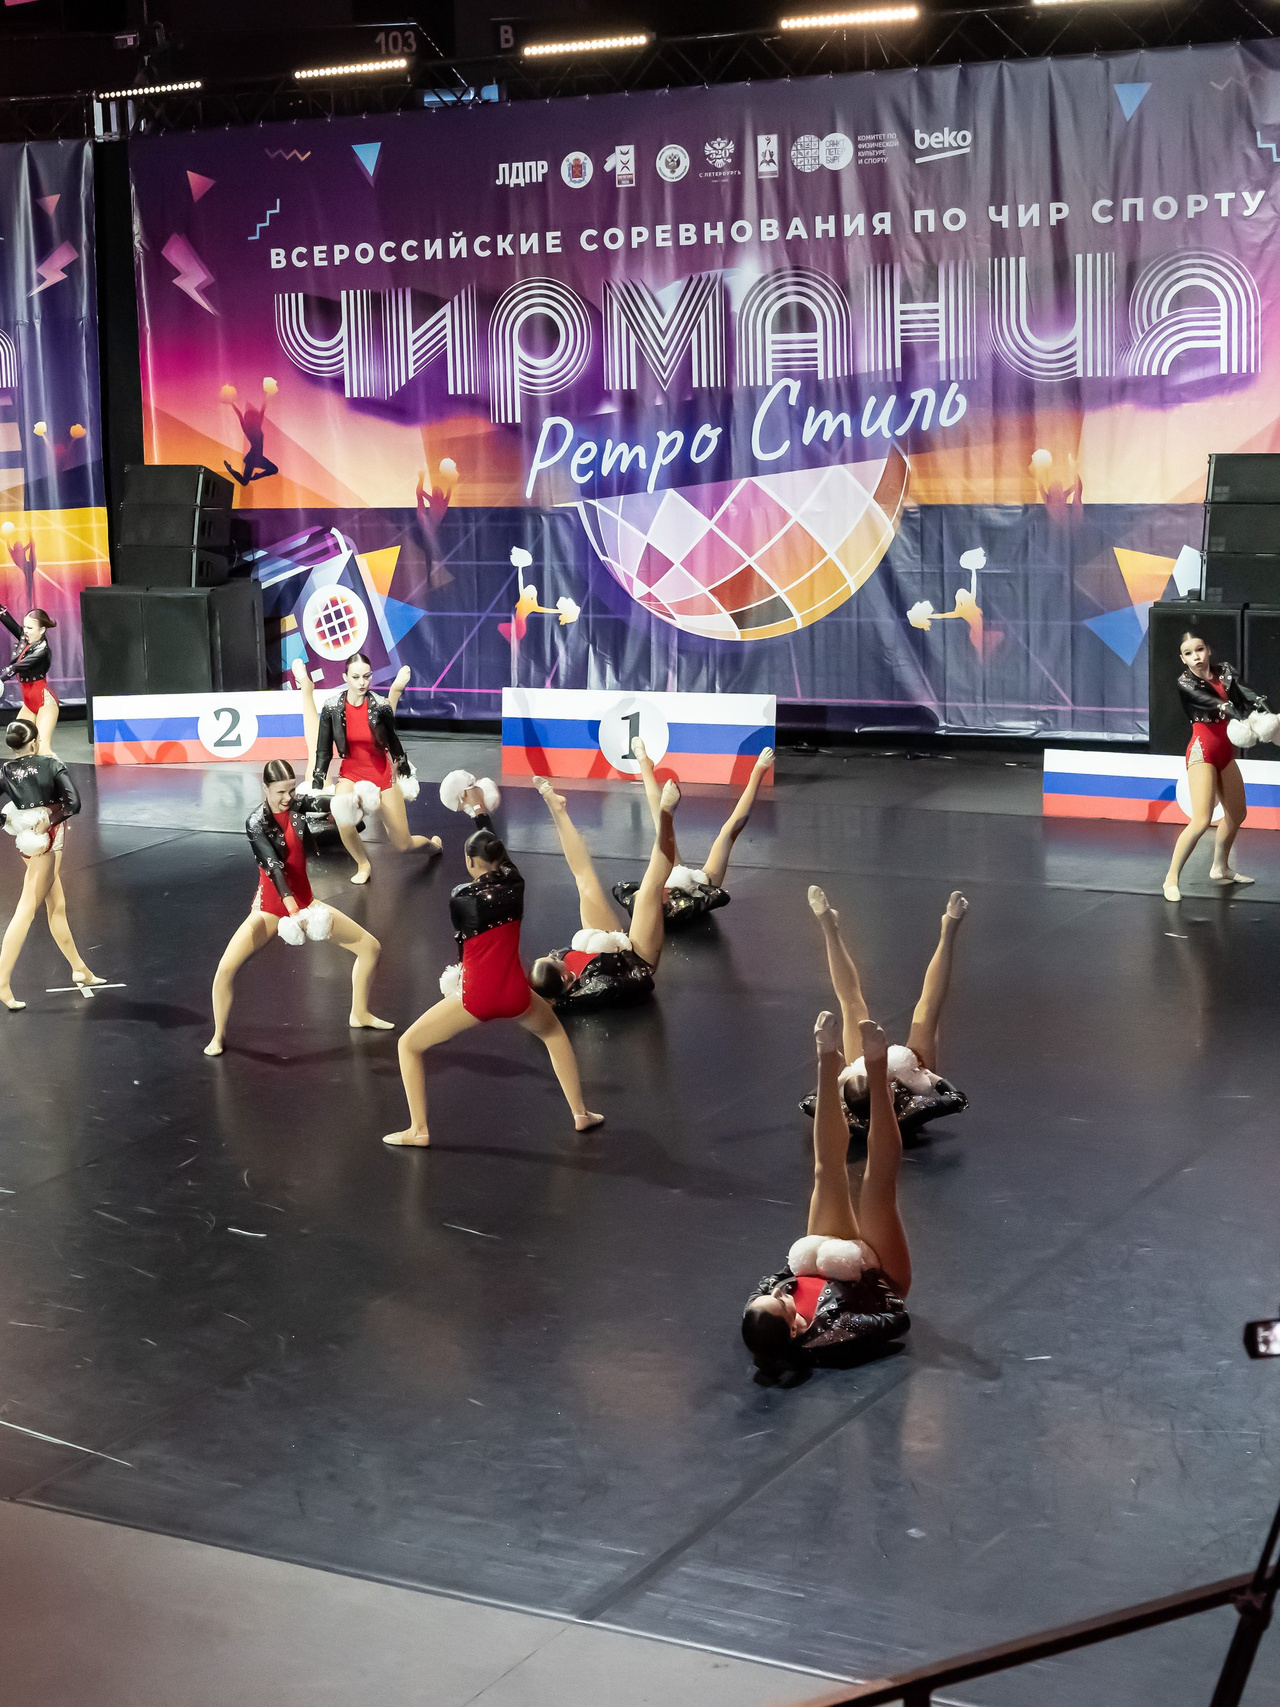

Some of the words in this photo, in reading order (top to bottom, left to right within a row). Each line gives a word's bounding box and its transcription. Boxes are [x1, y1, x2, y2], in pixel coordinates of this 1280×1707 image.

[374, 31, 417, 54] 103
[914, 127, 972, 150] beko
[495, 160, 549, 187] ЛДПР
[269, 230, 562, 269] ВСЕРОССИЙСКИЕ
[579, 211, 892, 252] СОРЕВНОВАНИЯ
[913, 207, 968, 234] ПО
[987, 200, 1070, 229] ЧИР
[1091, 190, 1267, 224] СПОРТУ
[524, 416, 722, 499] Ретро
[750, 377, 968, 462] Стиль
[212, 707, 242, 749] 2
[621, 711, 642, 759] 1
